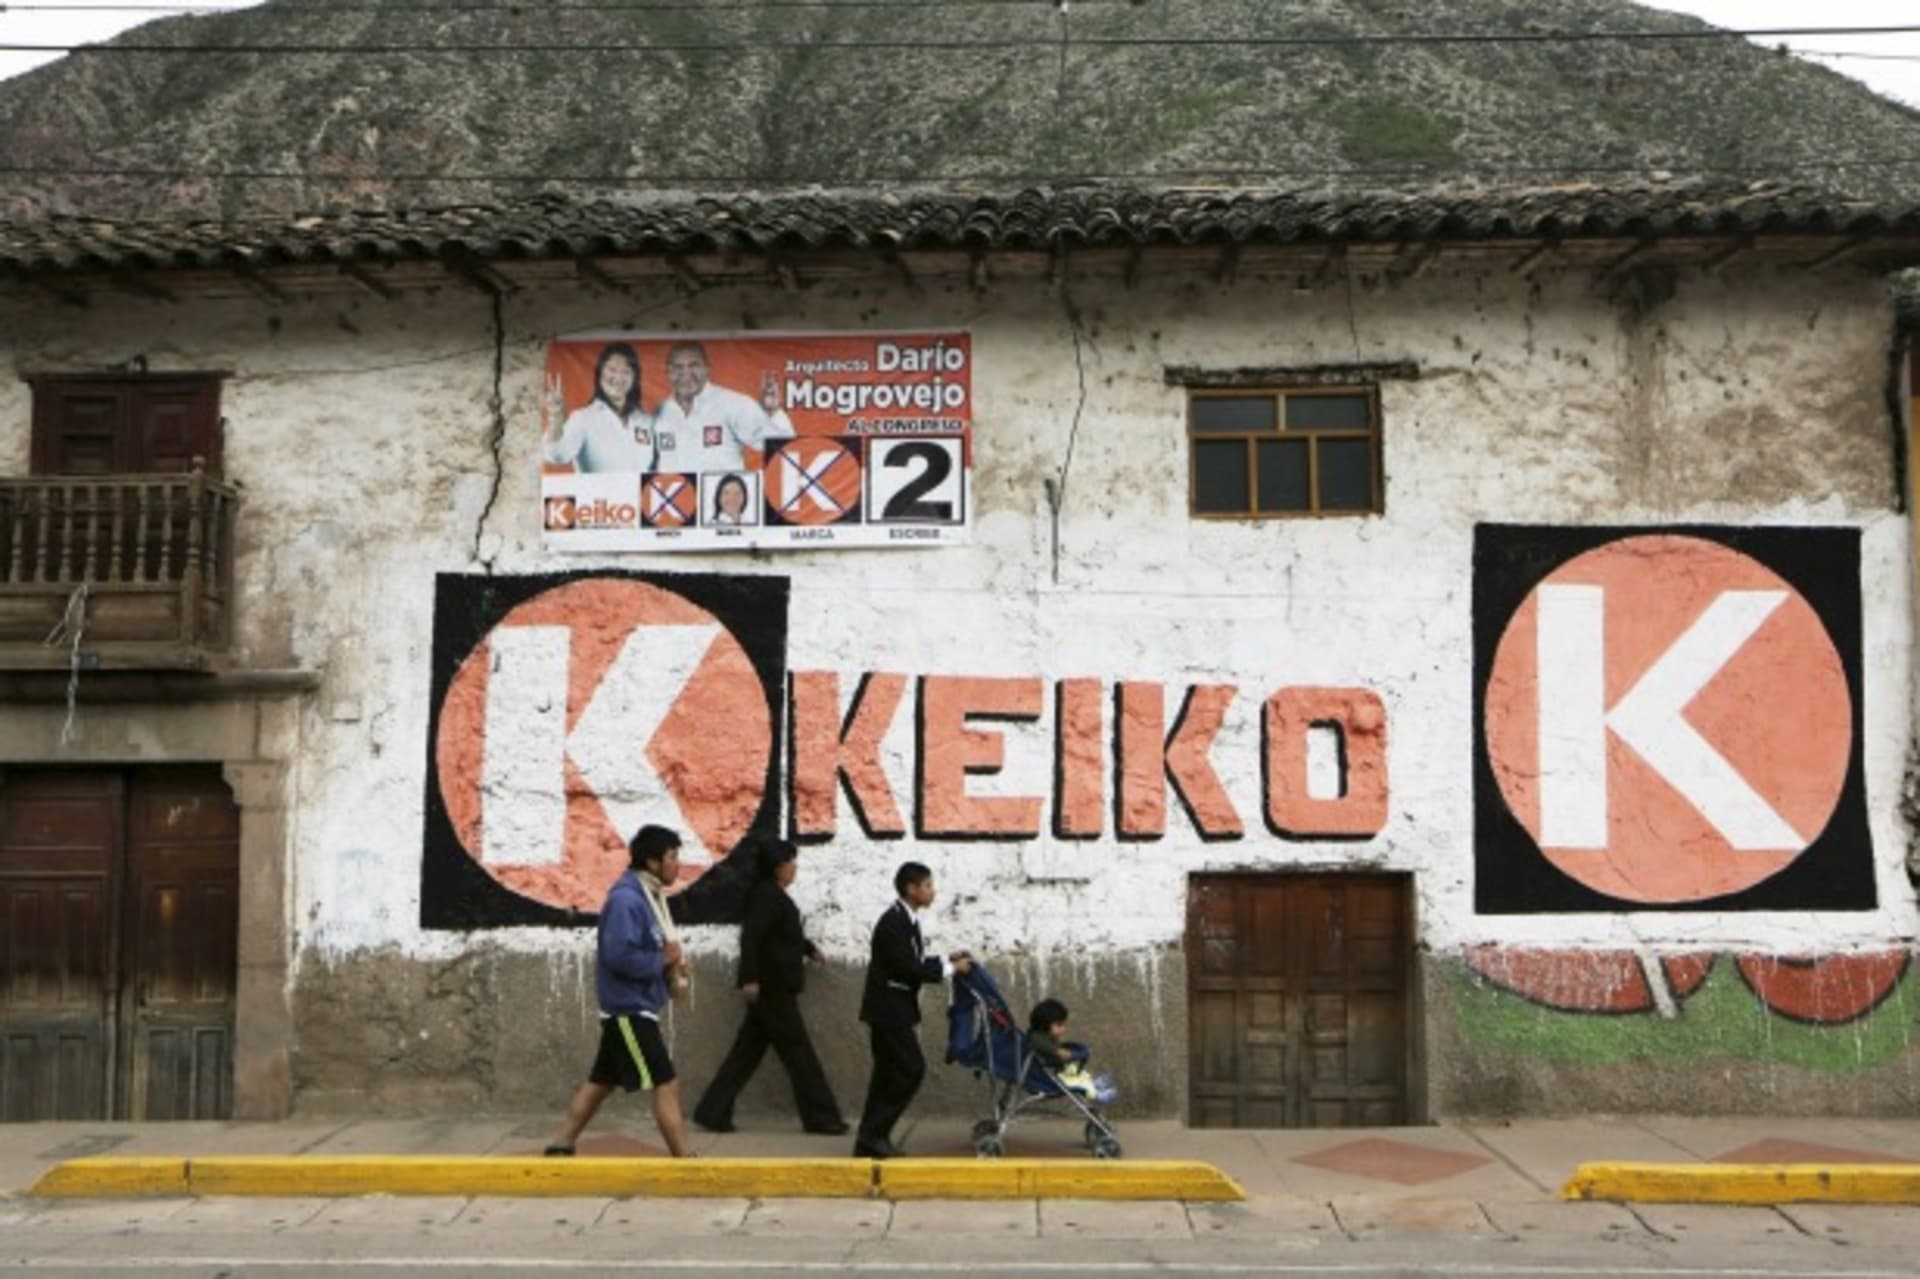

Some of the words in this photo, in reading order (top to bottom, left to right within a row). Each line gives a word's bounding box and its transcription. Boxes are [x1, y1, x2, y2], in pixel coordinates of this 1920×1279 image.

[786, 377, 965, 414] Mogrovejo
[882, 441, 953, 519] 2
[481, 624, 721, 865] K
[787, 670, 1389, 841] KEIKO
[1537, 584, 1809, 850] K
